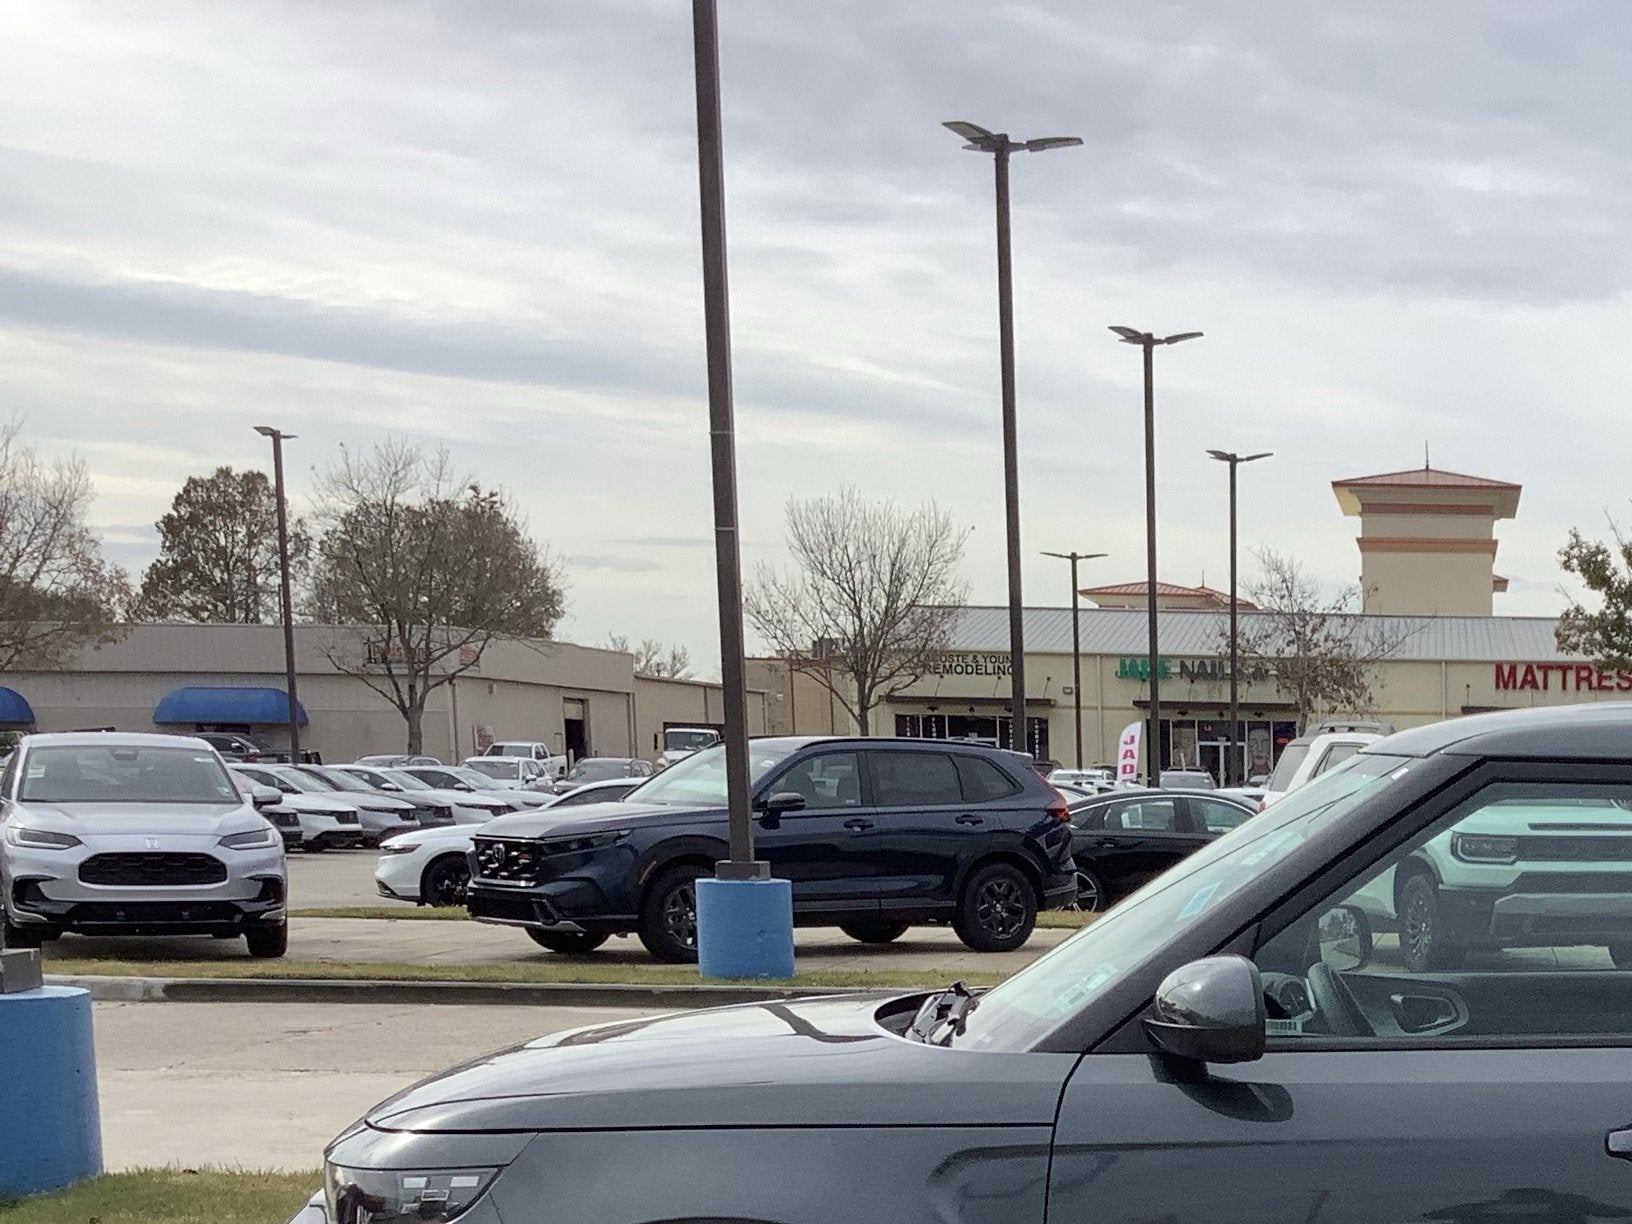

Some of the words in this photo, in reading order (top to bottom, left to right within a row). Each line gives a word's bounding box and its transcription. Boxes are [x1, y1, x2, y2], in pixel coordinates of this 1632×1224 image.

[982, 655, 1012, 664] YOUN
[1180, 659, 1243, 681] NAIL
[1122, 734, 1136, 775] JAD
